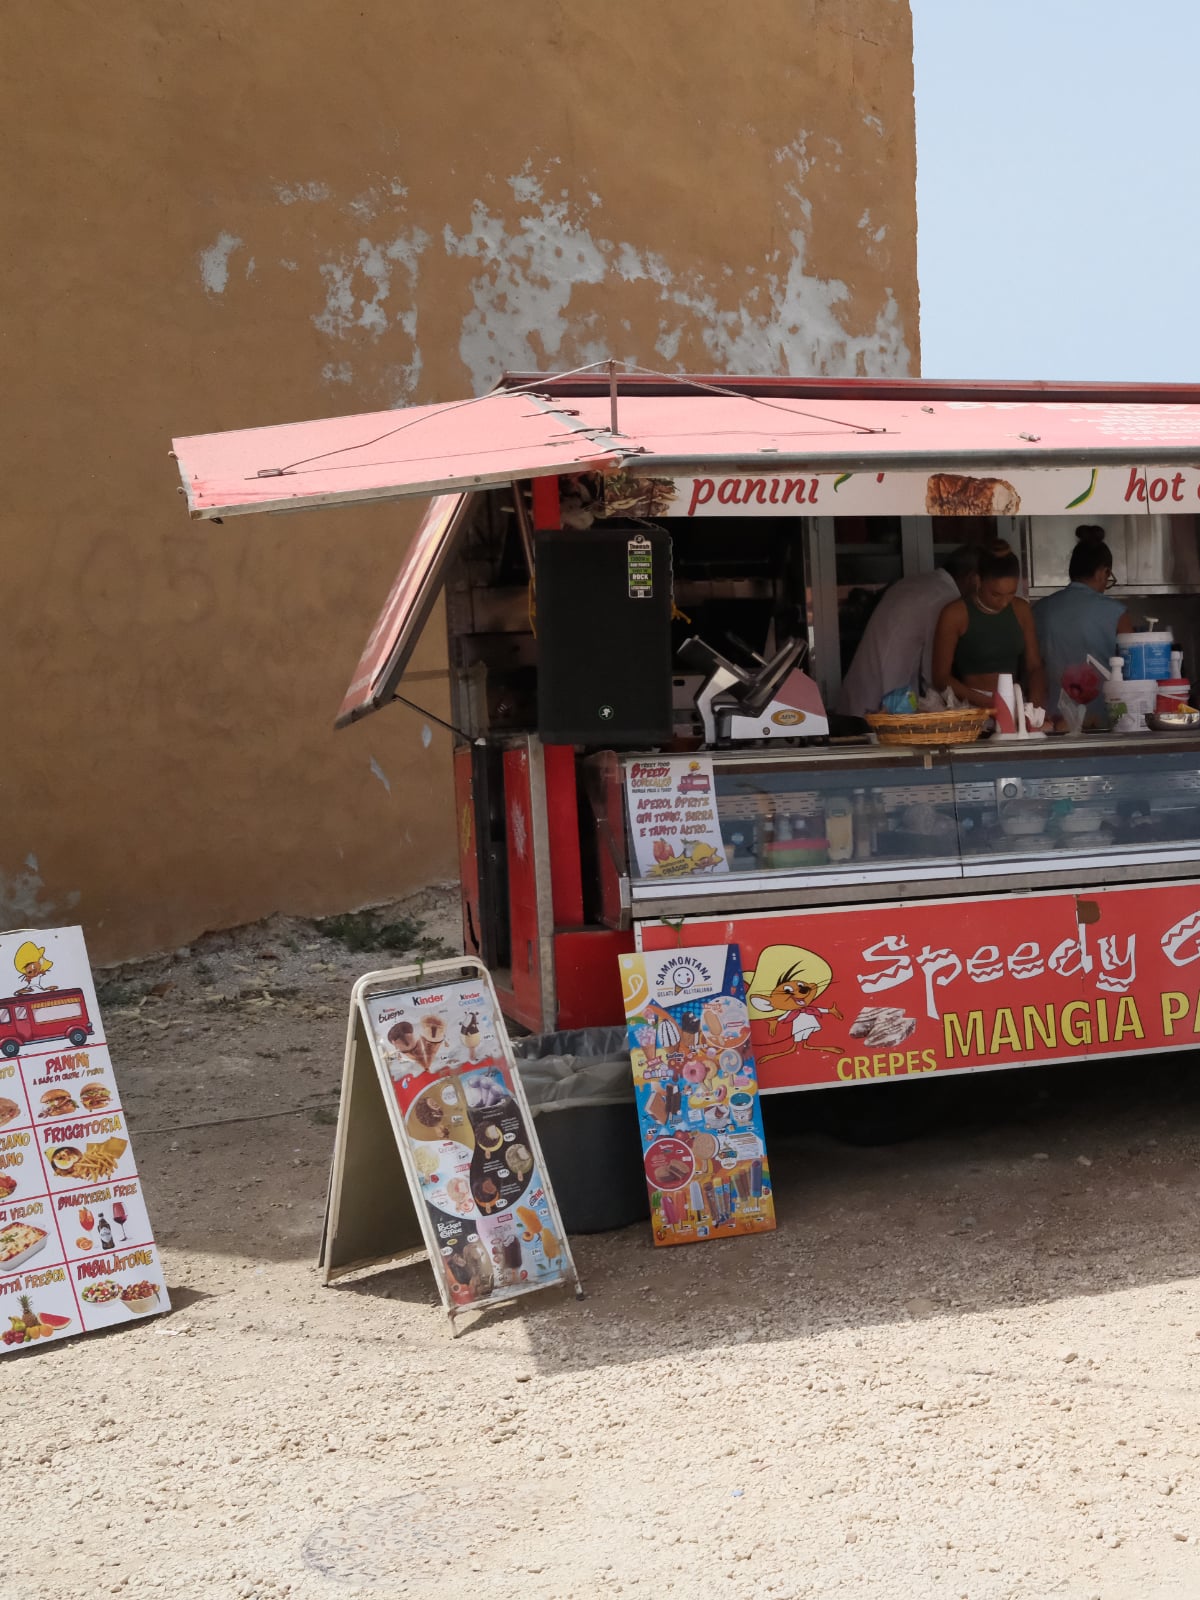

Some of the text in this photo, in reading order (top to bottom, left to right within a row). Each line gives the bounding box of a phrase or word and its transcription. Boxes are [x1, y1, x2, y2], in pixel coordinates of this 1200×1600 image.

[688, 474, 819, 516] panini
[1123, 467, 1186, 503] hot
[640, 828, 646, 837] E
[648, 825, 677, 837] TANTO
[656, 956, 711, 986] SAMMONTANA
[856, 920, 1138, 1020] Speedy
[411, 994, 444, 1006] Kinder
[460, 992, 481, 1000] Kinder
[378, 1009, 405, 1023] bueno
[942, 996, 1146, 1059] MANGIA
[45, 1052, 90, 1075] PANINI
[836, 1049, 938, 1081] CREPES
[43, 1115, 122, 1143] FRIGGITORIA
[113, 1183, 138, 1198] FREE
[10, 1202, 44, 1221] VELOCI
[24, 1268, 66, 1290] FRESCA
